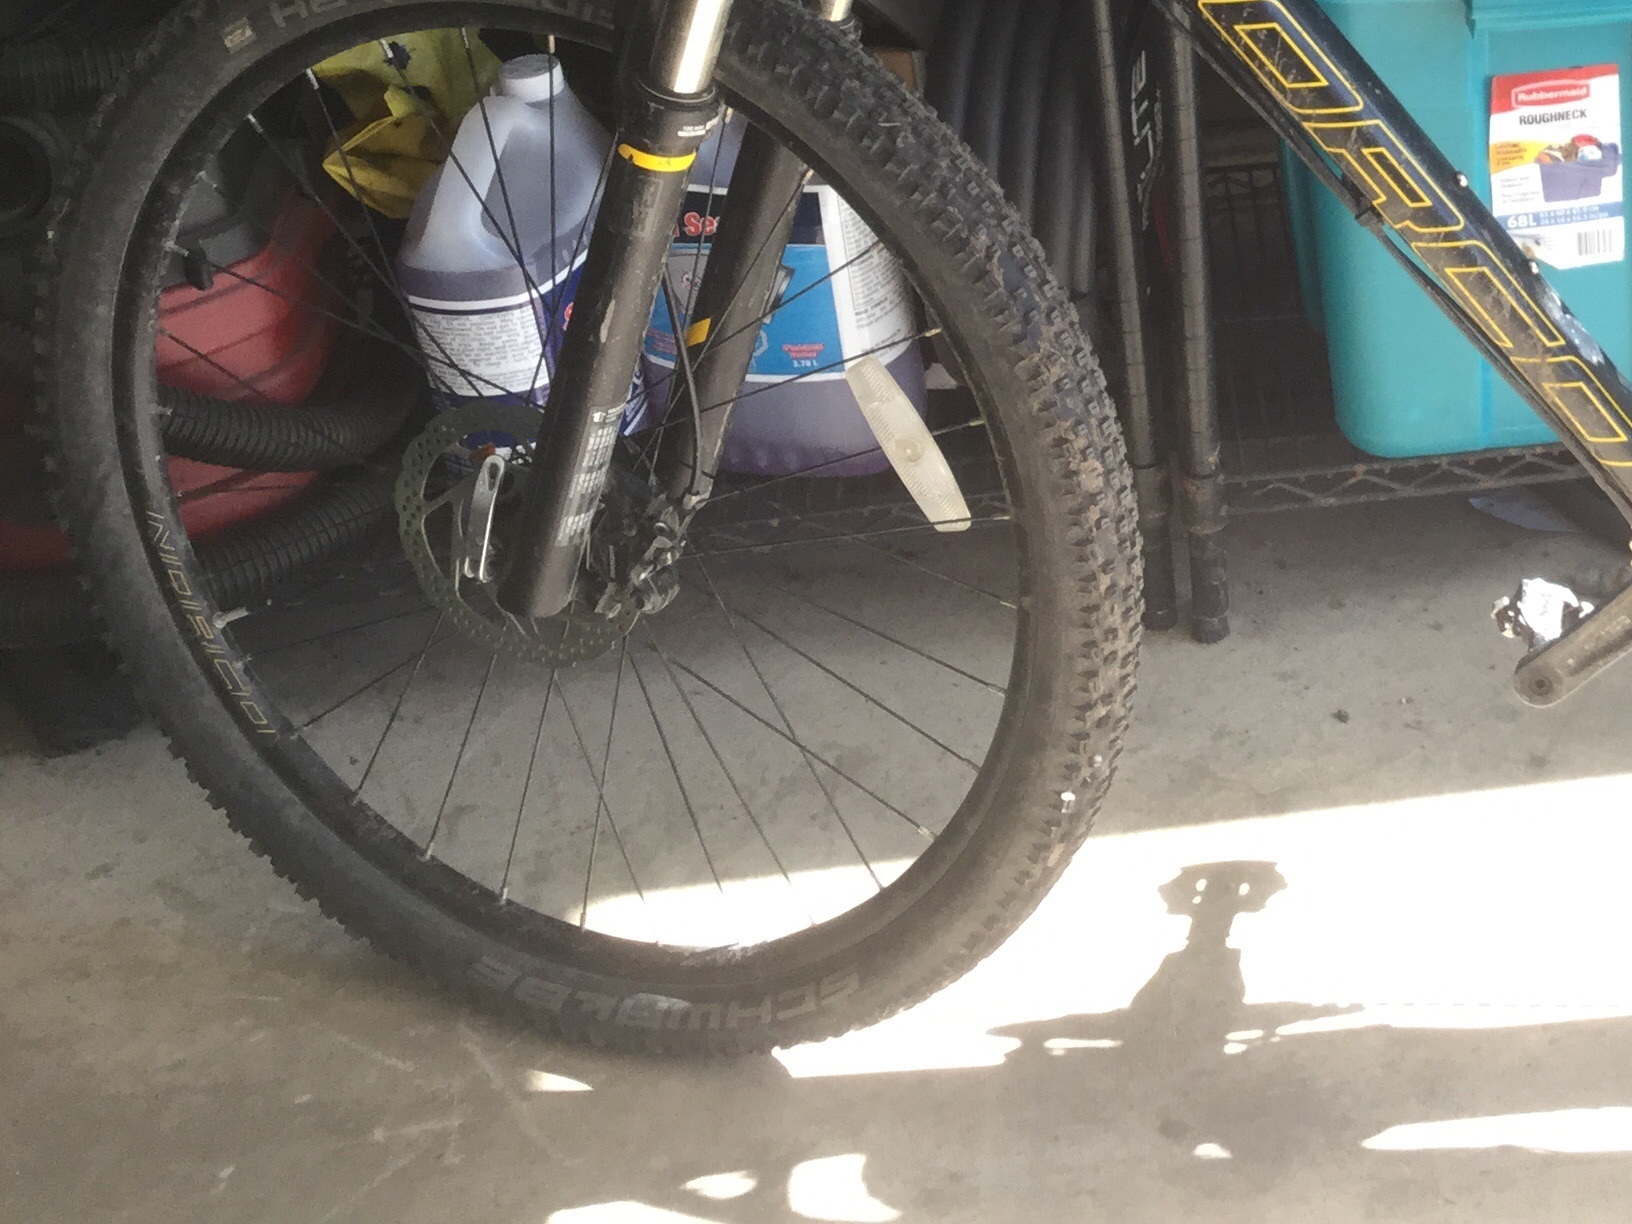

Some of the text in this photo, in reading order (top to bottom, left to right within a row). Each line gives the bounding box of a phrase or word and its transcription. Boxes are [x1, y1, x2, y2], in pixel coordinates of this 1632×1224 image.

[1517, 88, 1588, 102] Rubbermaid
[1519, 108, 1588, 126] ROUGHNECK
[1507, 213, 1537, 228] 68L
